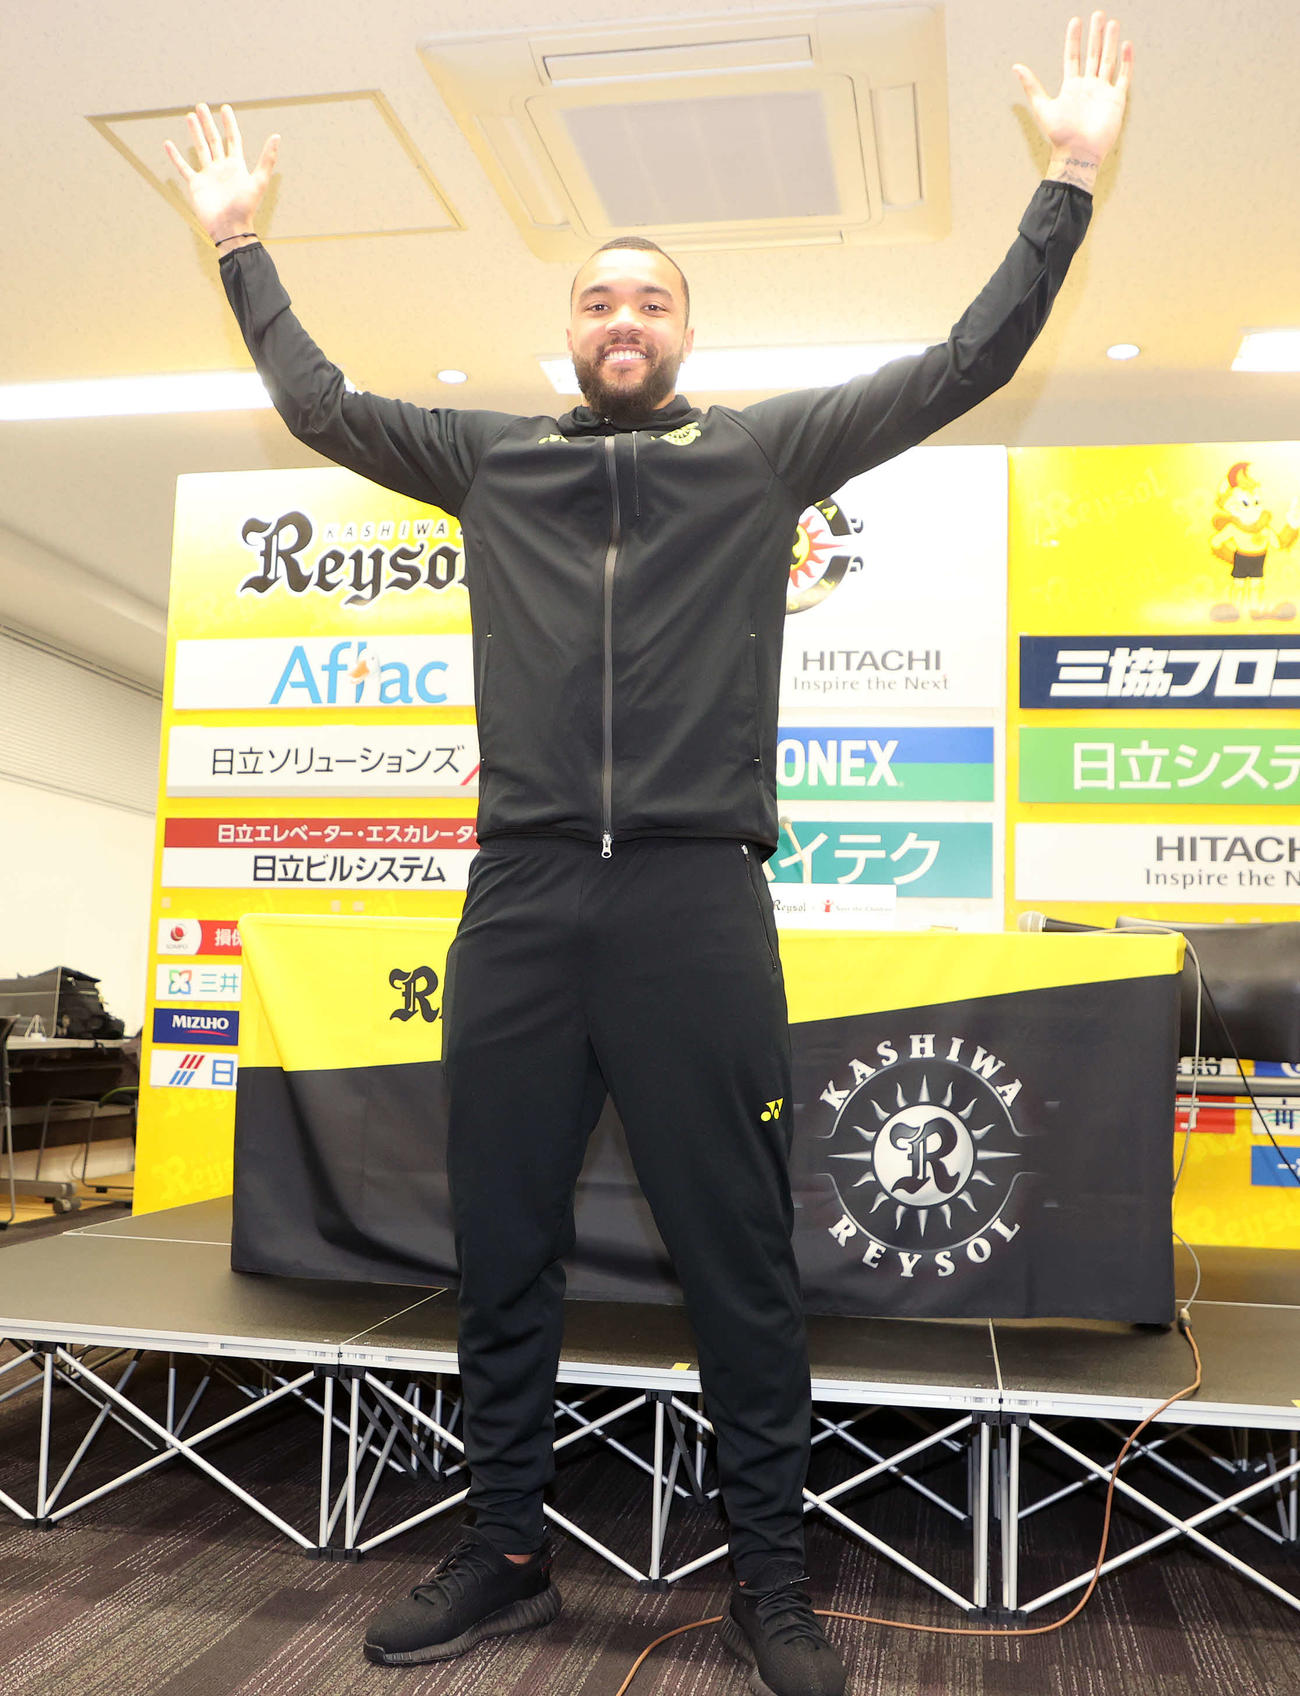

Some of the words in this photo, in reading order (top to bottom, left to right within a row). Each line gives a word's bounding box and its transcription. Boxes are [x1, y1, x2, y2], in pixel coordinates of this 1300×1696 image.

[325, 522, 447, 538] KASHIWA
[240, 511, 469, 606] Reyso
[269, 641, 449, 704] Aflac
[801, 650, 941, 671] HITACHI
[793, 677, 860, 693] Inspire
[867, 677, 897, 690] the
[904, 675, 950, 690] Next
[211, 745, 465, 776] 日立ソリューションズ
[1073, 740, 1300, 790] 日立システ
[217, 824, 478, 844] 日立エレベーター・エスカレータ
[252, 854, 447, 883] 日立ビルシステム
[761, 832, 940, 885] イテク
[1145, 869, 1229, 889] Inspire
[1238, 869, 1276, 886] the
[773, 899, 807, 913] Reysol
[200, 973, 239, 994] 三井
[389, 965, 443, 1023] R
[171, 1014, 229, 1031] MIZUHO
[211, 1059, 237, 1086] 日
[819, 1033, 1023, 1111] KASHIWA
[889, 1116, 960, 1195] R
[828, 1214, 1021, 1278] REYSOL
